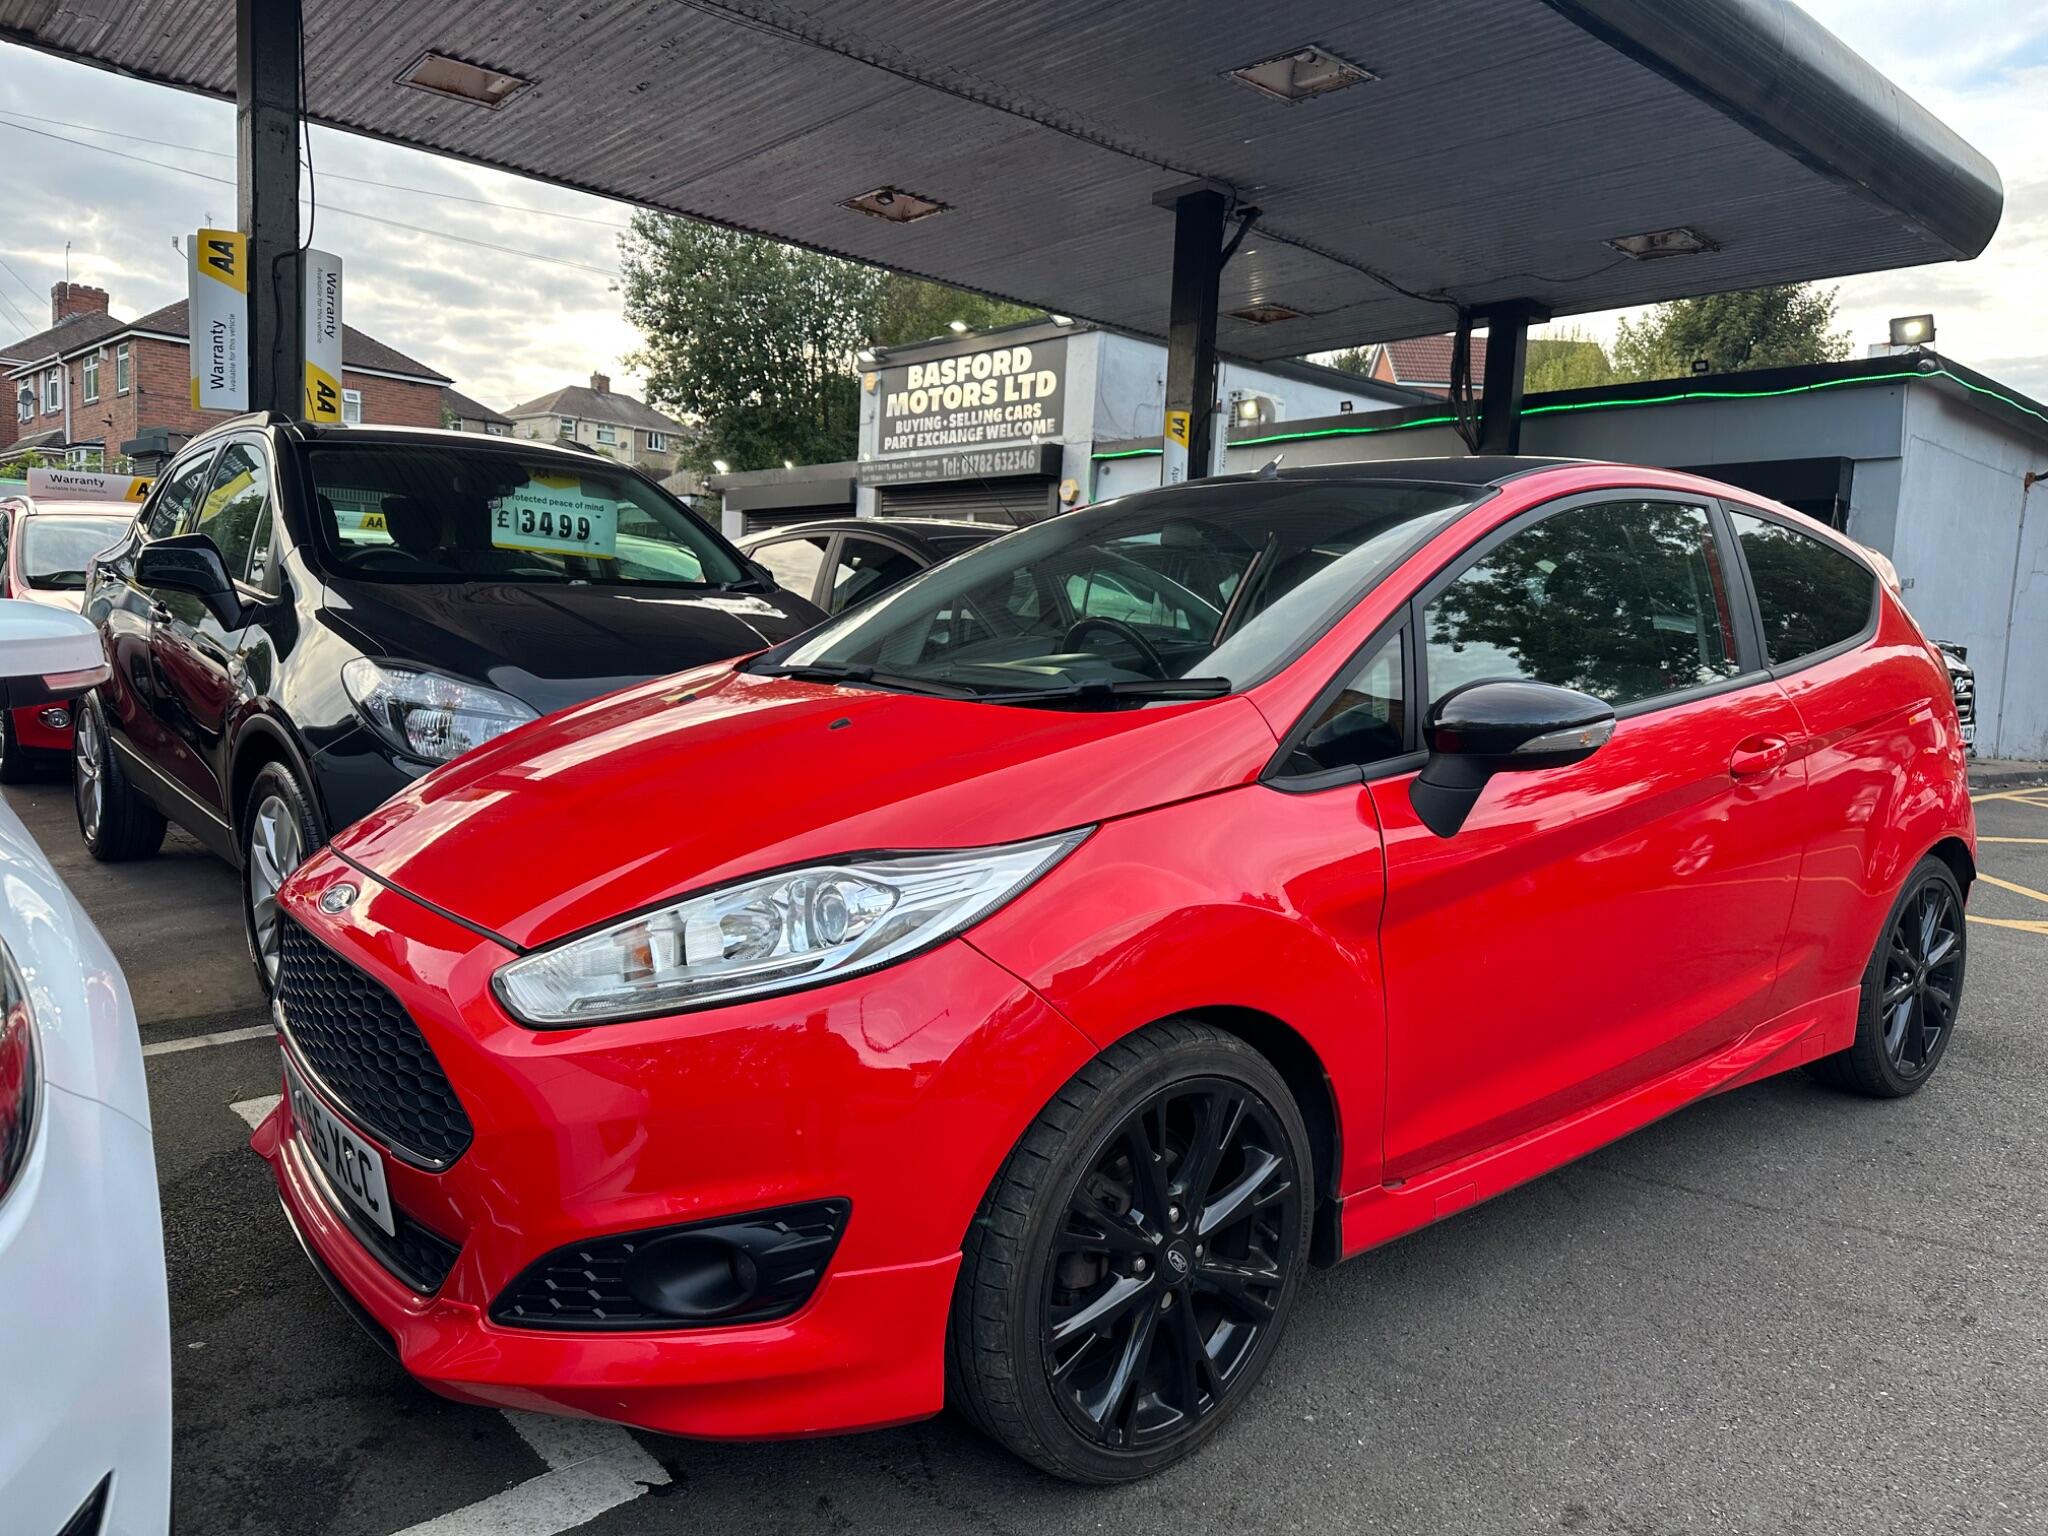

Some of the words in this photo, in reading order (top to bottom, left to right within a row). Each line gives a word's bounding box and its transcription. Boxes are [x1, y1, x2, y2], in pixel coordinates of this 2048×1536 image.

[208, 240, 234, 275] AA
[324, 272, 337, 339] Warranty
[210, 320, 227, 390] Warranty
[907, 346, 1033, 390] BASFORD
[317, 379, 336, 414] AA
[886, 379, 998, 418] MOTORS
[1004, 370, 1057, 402] LTD
[884, 434, 915, 450] PART
[916, 426, 983, 447] EXCHANGE
[985, 418, 1056, 440] WELCOME
[895, 415, 942, 434] BUYING
[949, 408, 1002, 428] SELLING
[1004, 402, 1042, 421] CARS
[1172, 417, 1185, 439] AA
[50, 473, 105, 488] Warranty
[136, 482, 149, 497] A
[366, 516, 383, 529] AA
[548, 498, 573, 508] peace
[574, 501, 584, 509] of
[584, 503, 605, 512] mind
[327, 1120, 380, 1214] XCC
